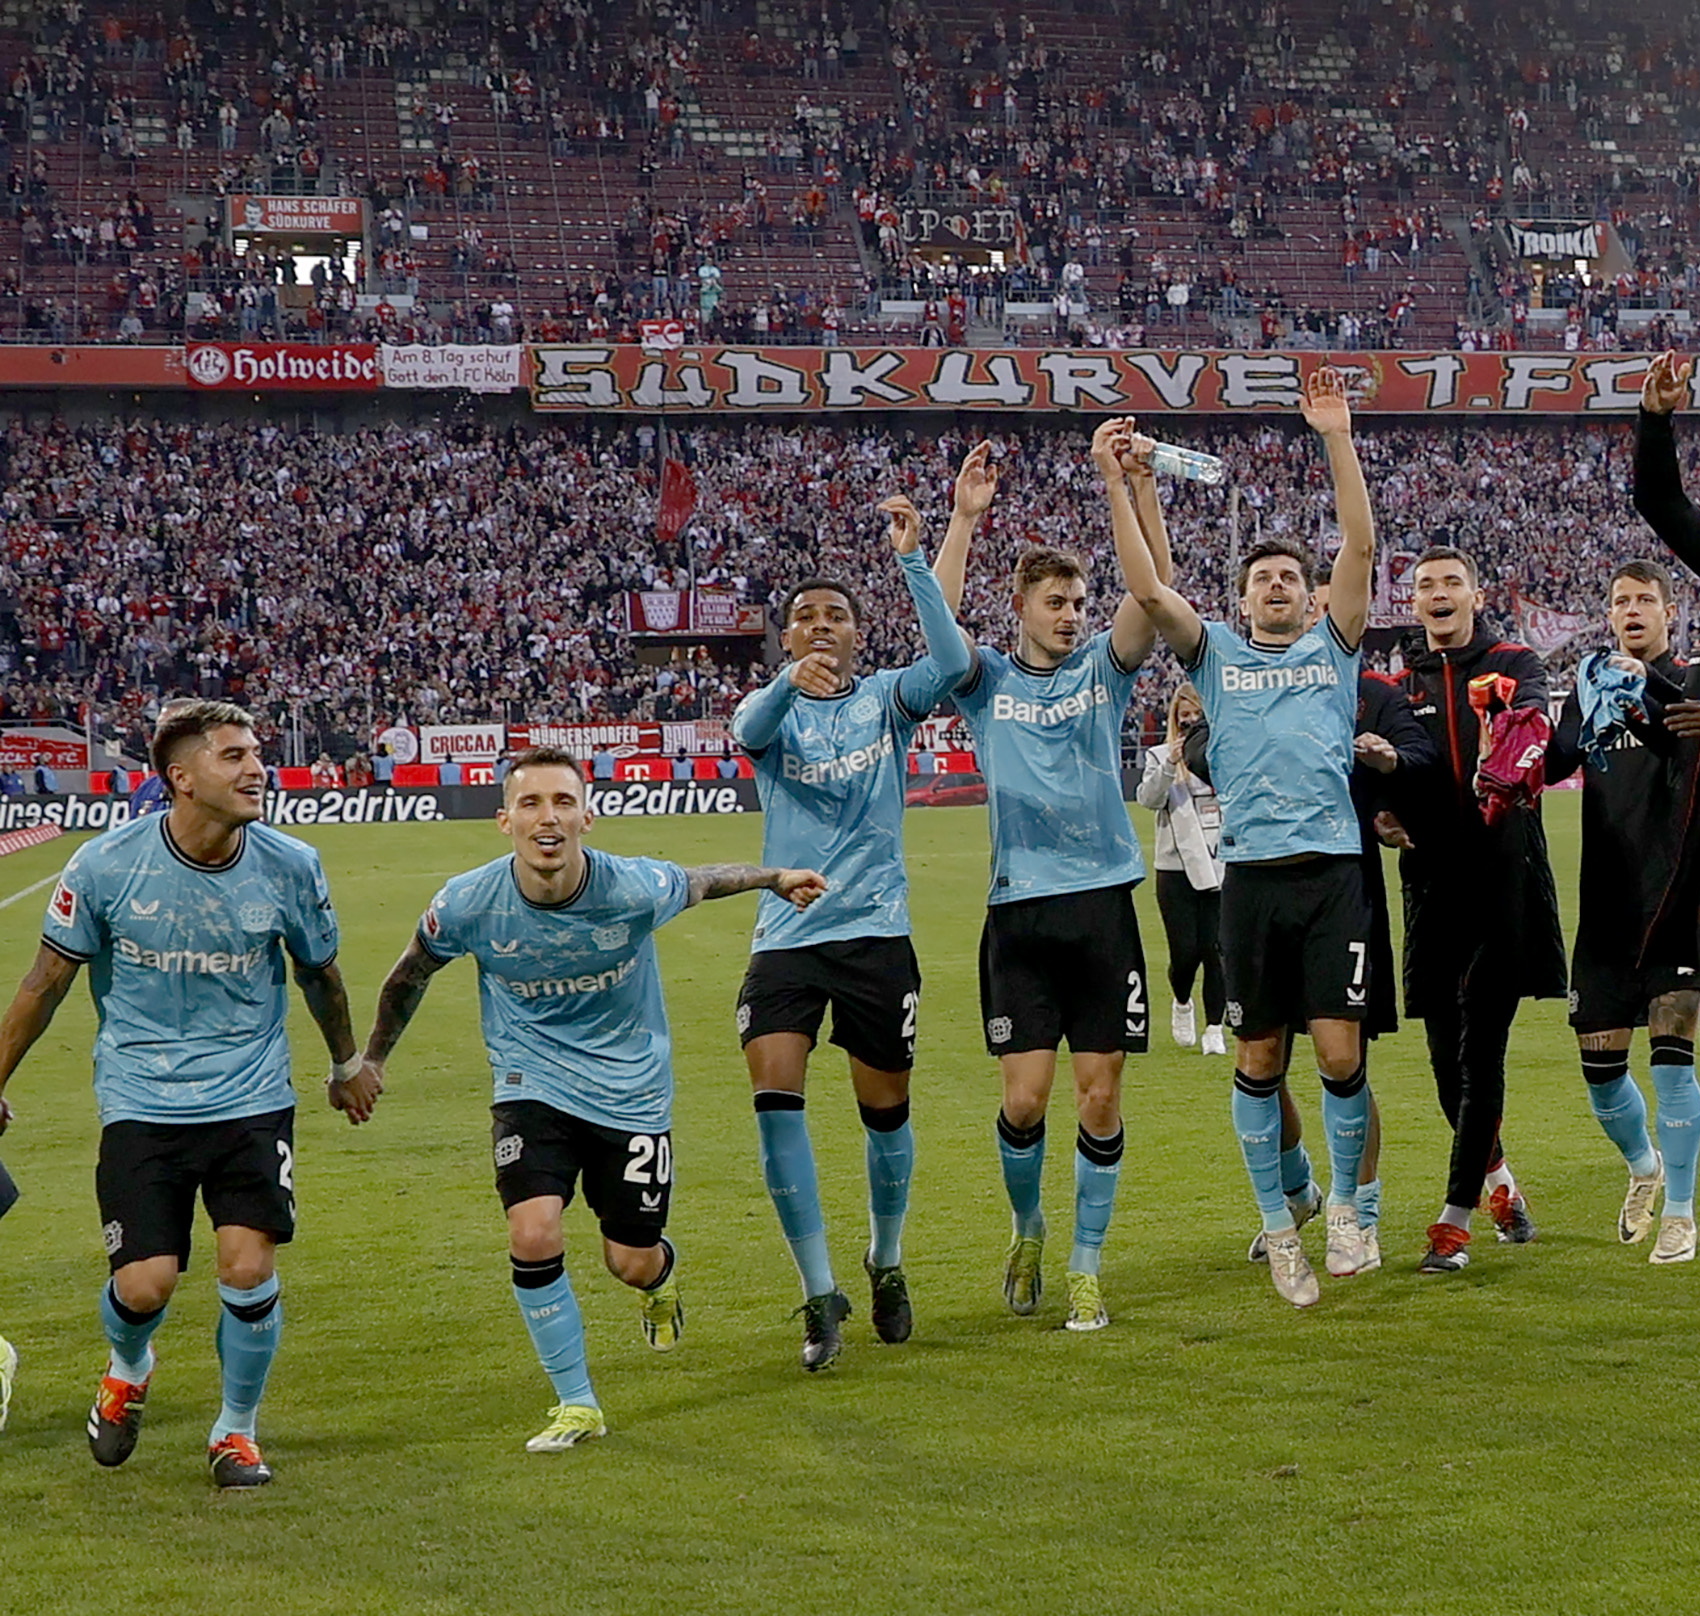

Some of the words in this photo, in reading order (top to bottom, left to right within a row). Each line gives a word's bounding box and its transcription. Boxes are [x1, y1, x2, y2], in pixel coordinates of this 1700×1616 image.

[268, 201, 300, 213] HANS
[302, 200, 357, 214] SCHÄFER
[268, 214, 331, 229] SÜDKURVE
[1510, 224, 1599, 258] TROIKA
[642, 322, 683, 342] FC
[232, 348, 376, 385] Holweide
[392, 349, 418, 363] Am
[422, 349, 435, 364] 8.
[439, 349, 464, 366] Tag
[469, 348, 511, 364] schuf
[388, 368, 418, 383] Gott
[423, 369, 448, 383] den
[484, 366, 516, 383] Köln
[534, 348, 1303, 409] SÜDKURVE
[1221, 659, 1339, 692] Barmenia
[993, 684, 1109, 725] Barmena
[430, 734, 497, 755] CRICCAA
[528, 725, 640, 745] MÜNGERSDORFER
[1348, 942, 1365, 985] 7
[1127, 970, 1145, 1014] 2
[623, 1135, 670, 1184] 20
